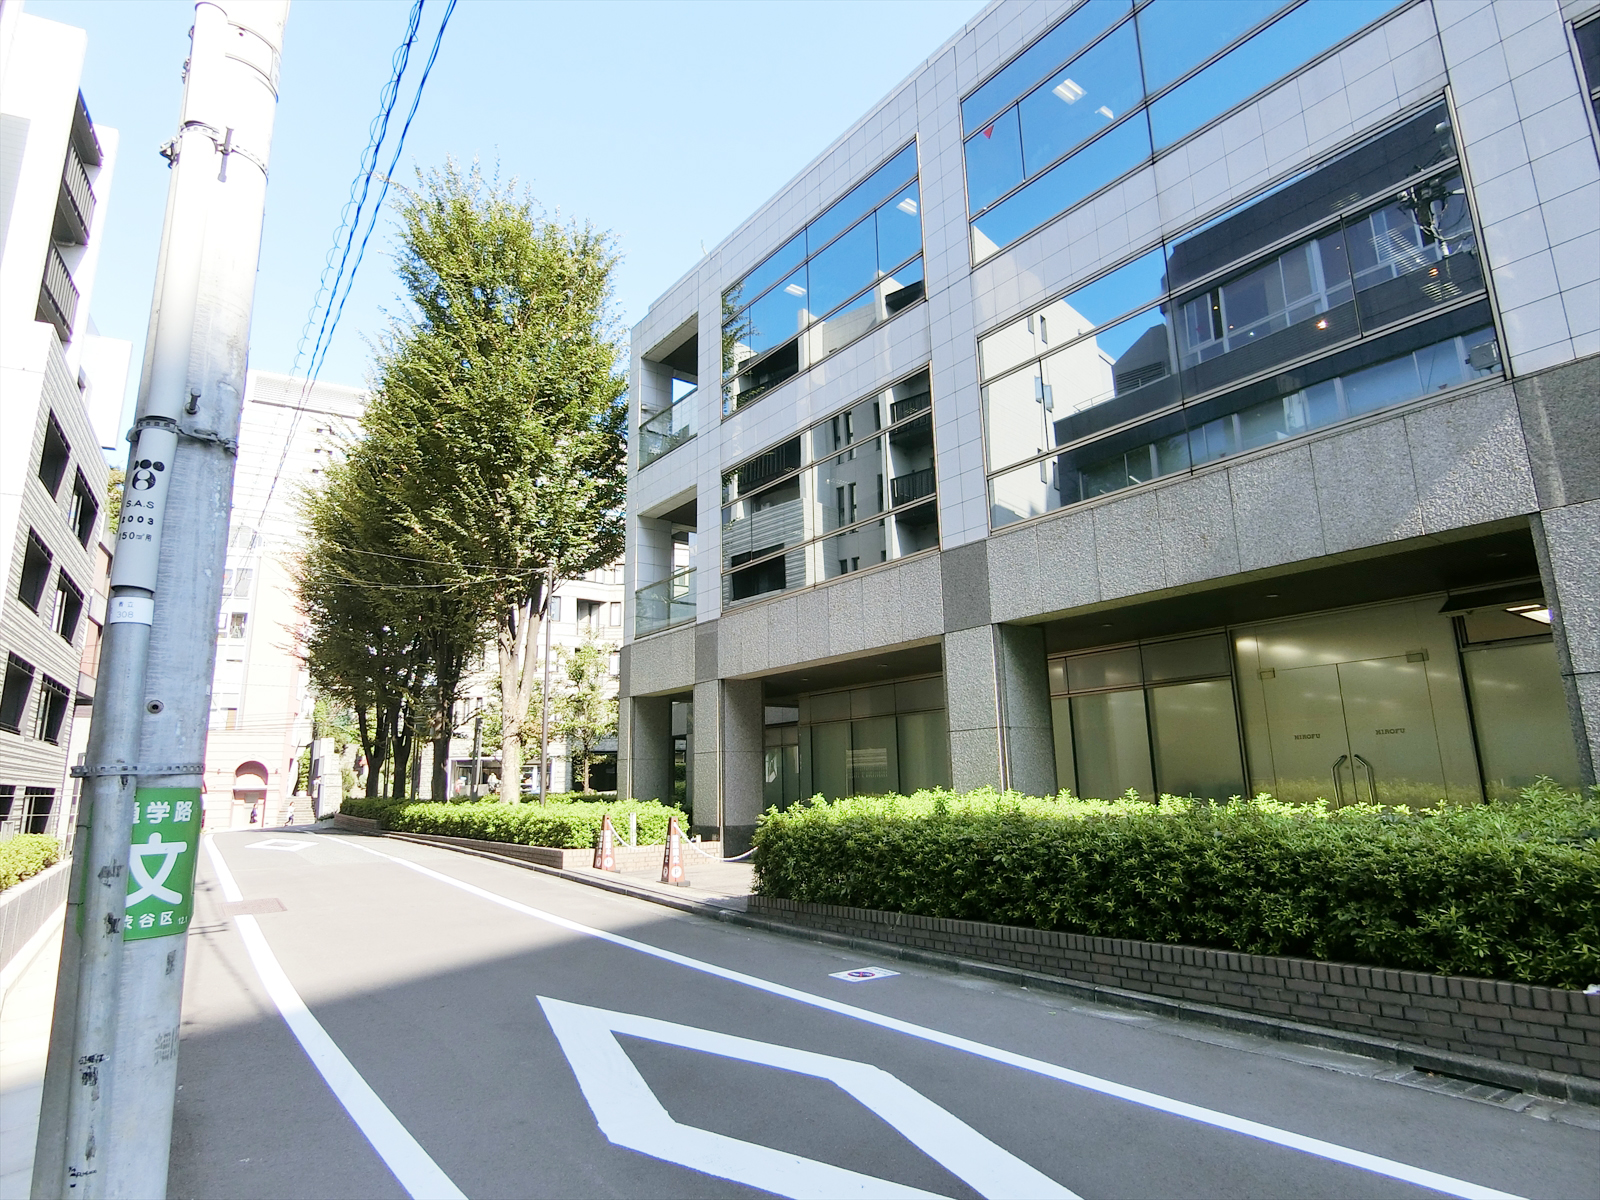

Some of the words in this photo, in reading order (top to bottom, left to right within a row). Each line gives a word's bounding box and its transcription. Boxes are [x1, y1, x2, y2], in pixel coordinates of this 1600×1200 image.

[126, 500, 155, 509] S.A.S
[116, 610, 134, 619] 308
[125, 832, 187, 908] 文
